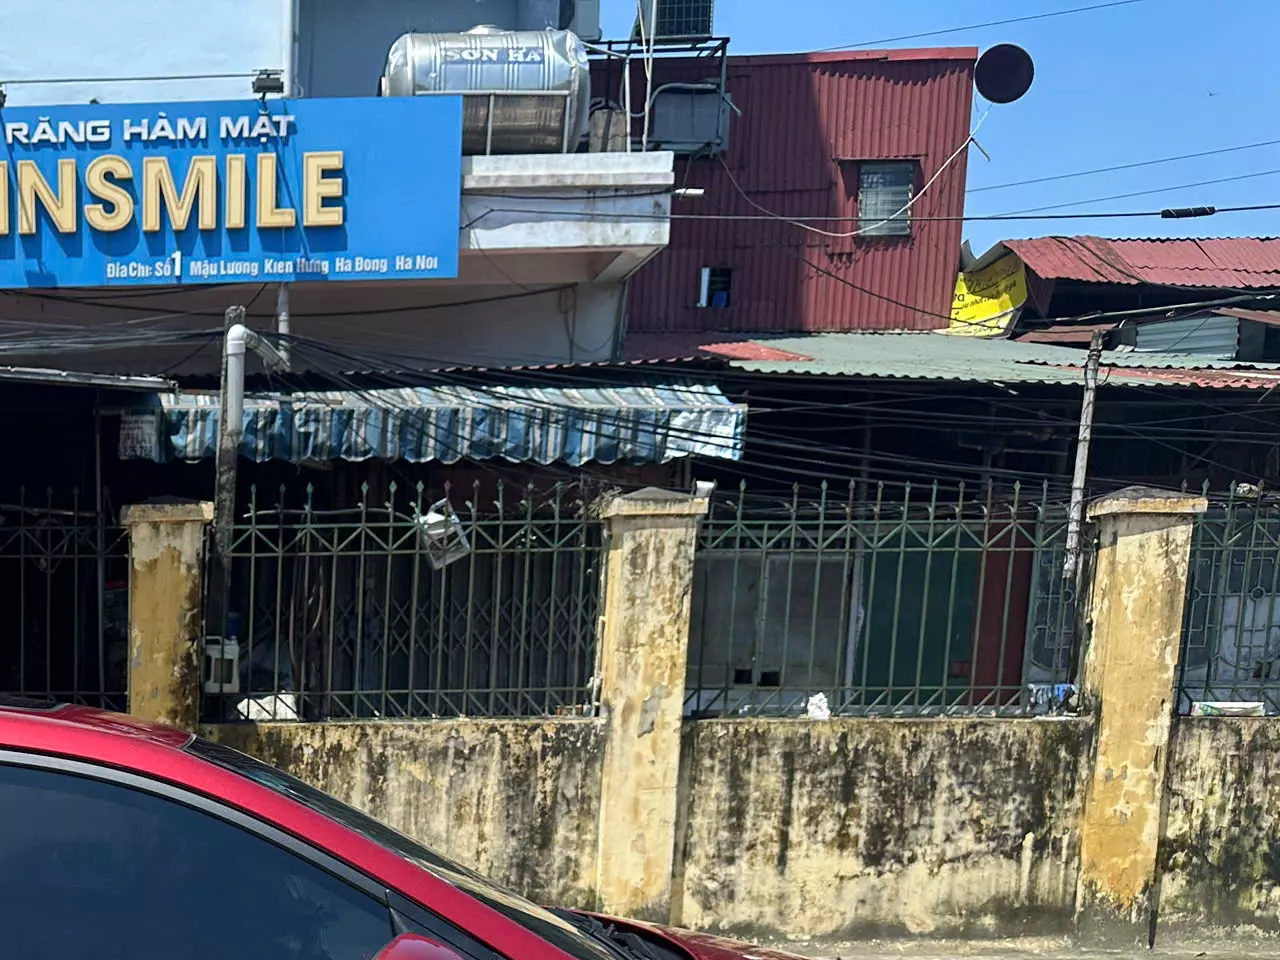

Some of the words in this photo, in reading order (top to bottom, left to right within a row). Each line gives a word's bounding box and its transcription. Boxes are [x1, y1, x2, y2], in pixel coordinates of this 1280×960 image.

[6, 116, 111, 145] RĂNG
[123, 112, 207, 141] HÀM
[220, 111, 296, 143] MẶT
